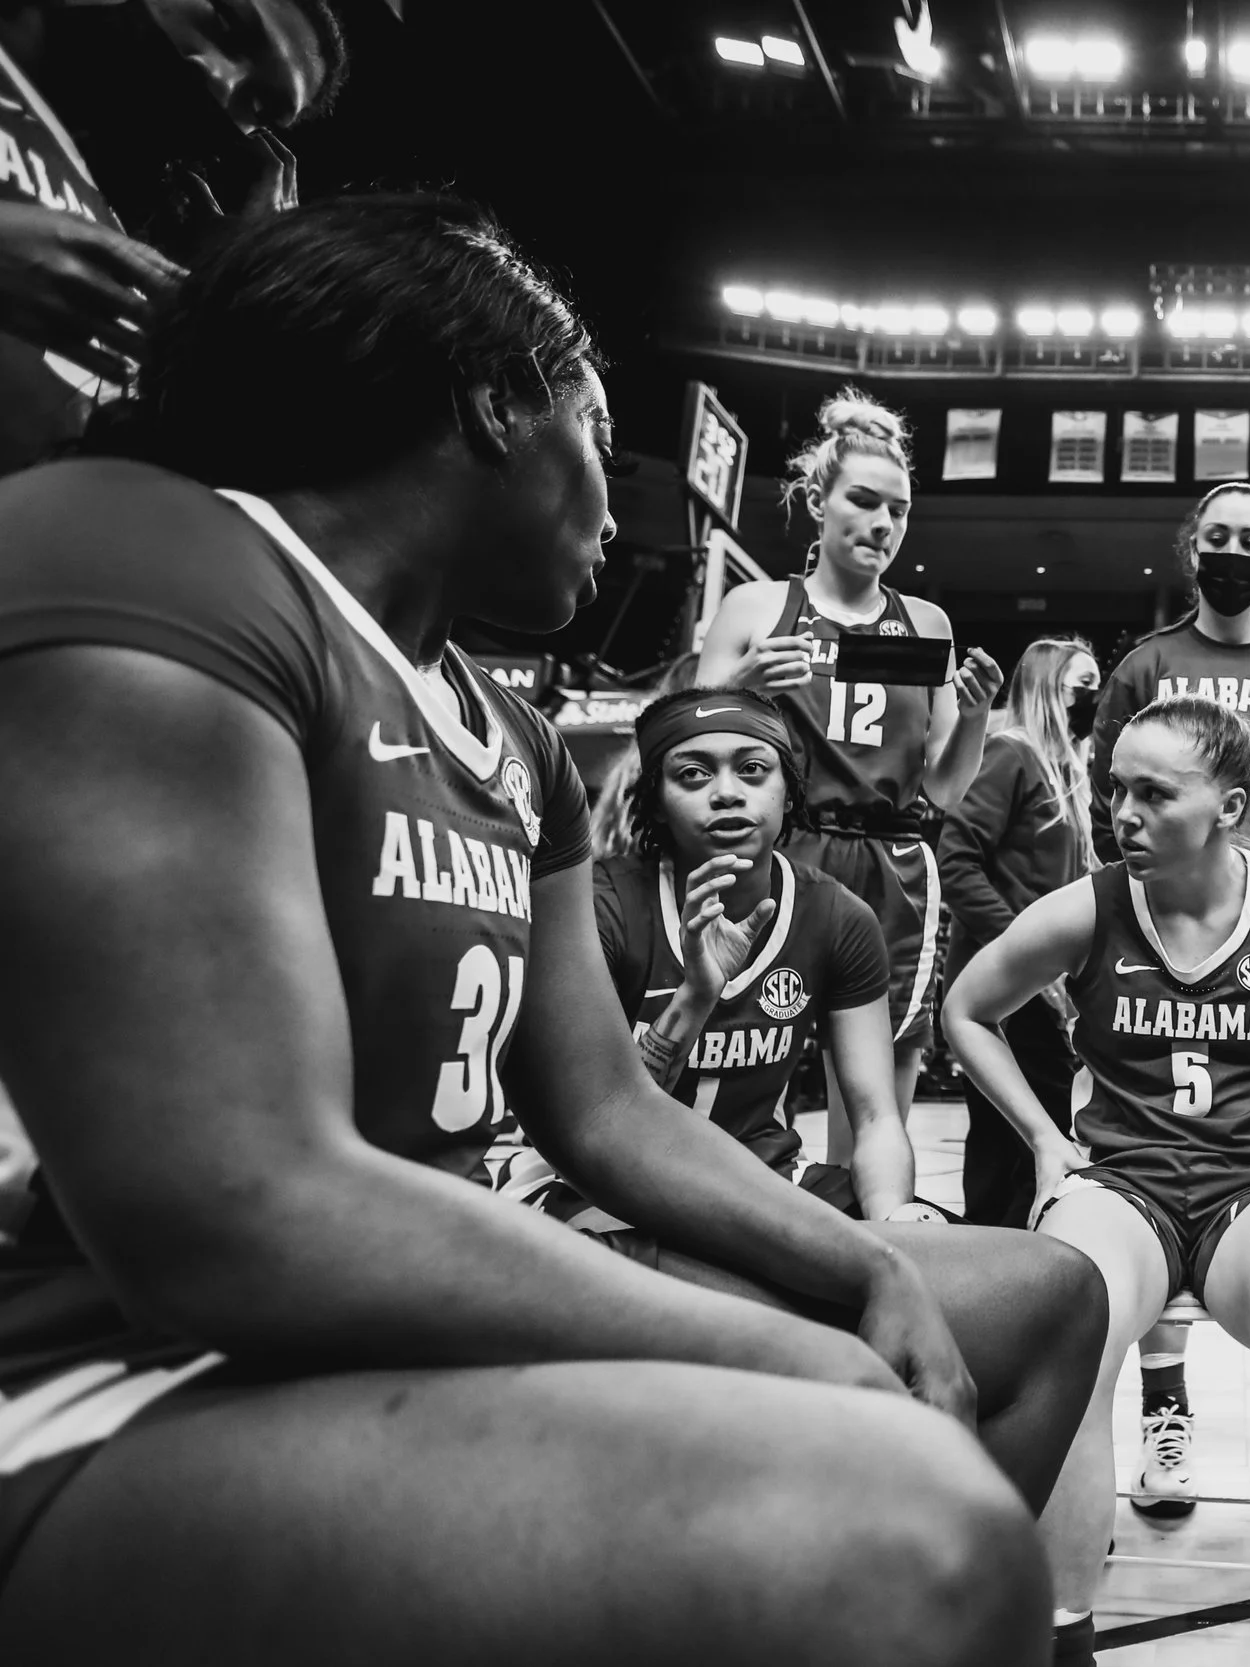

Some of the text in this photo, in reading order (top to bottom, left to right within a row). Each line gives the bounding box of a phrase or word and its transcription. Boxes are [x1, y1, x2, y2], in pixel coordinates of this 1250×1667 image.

[480, 667, 536, 689] AN
[827, 677, 887, 748] 12
[763, 1000, 805, 1019] GRADUATE
[766, 971, 800, 1007] SEC
[633, 1022, 795, 1070] BAMA
[1171, 1051, 1212, 1118] 5
